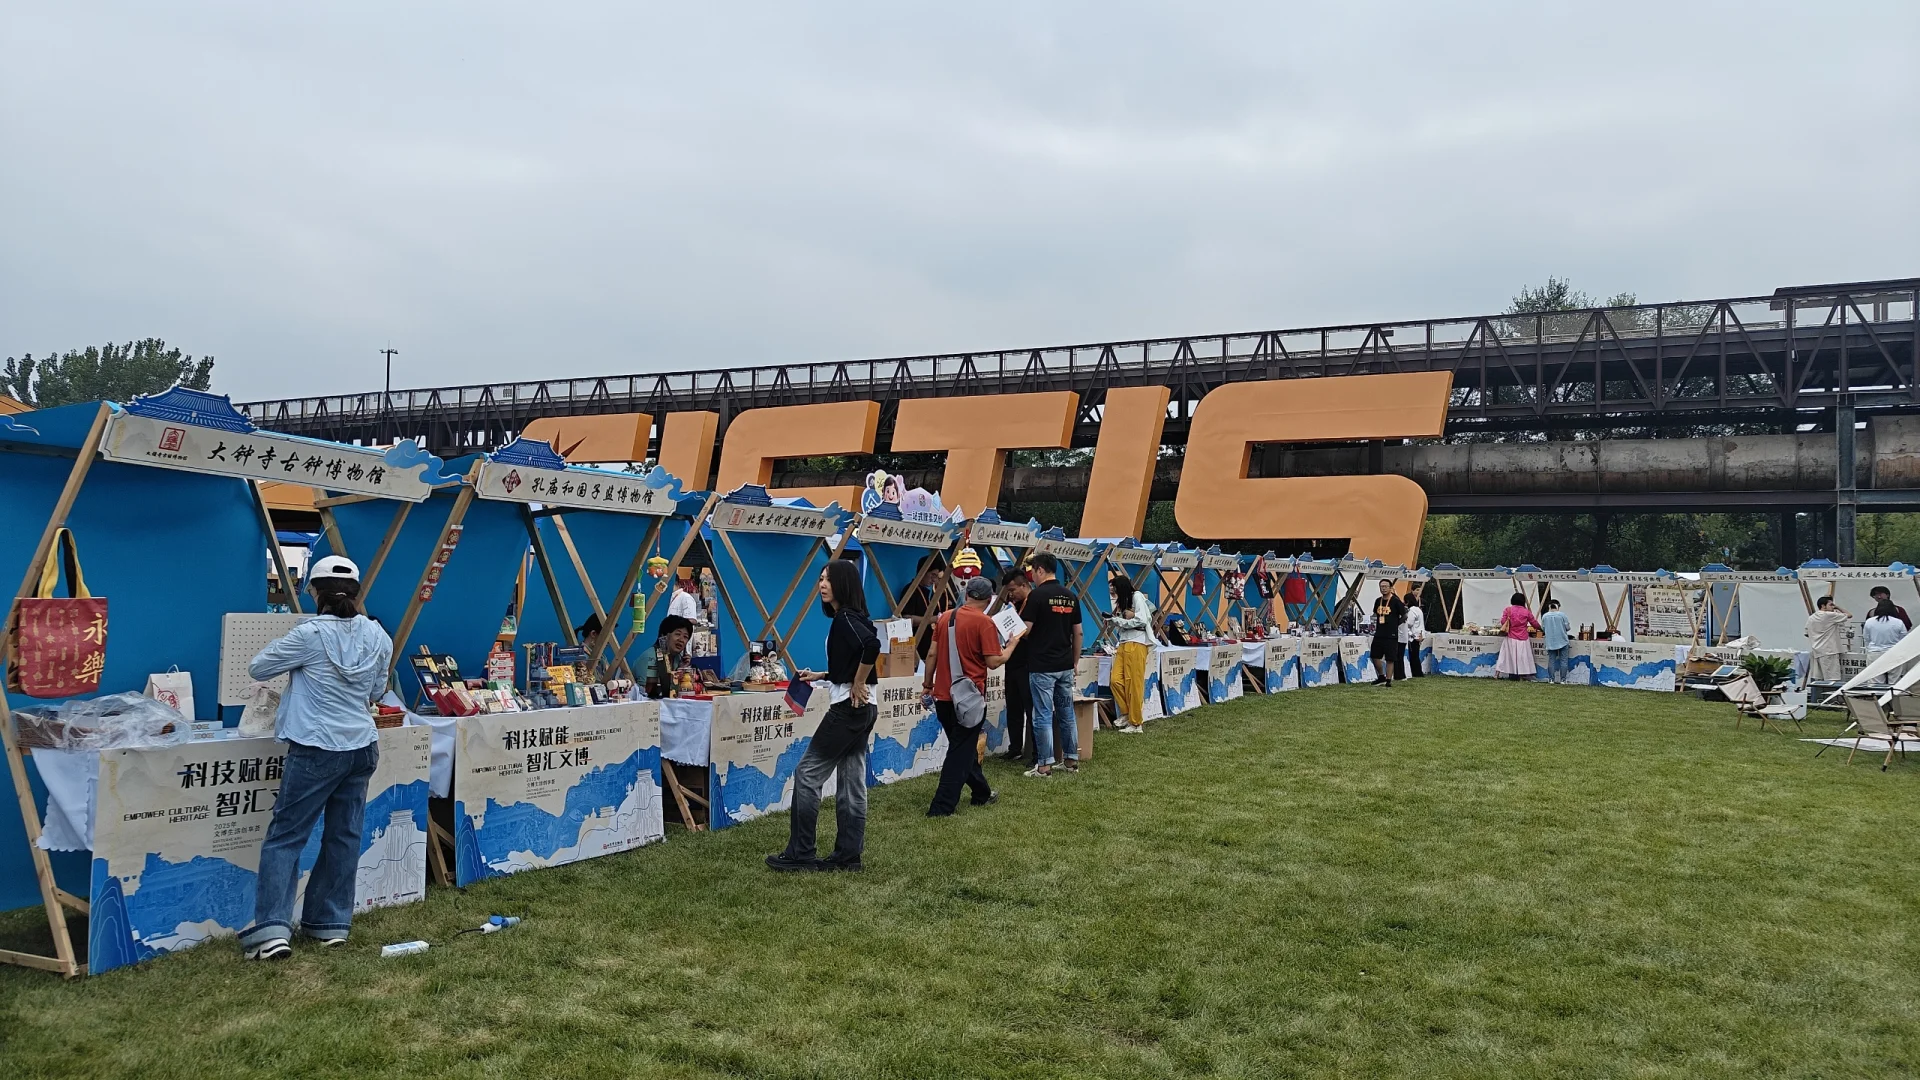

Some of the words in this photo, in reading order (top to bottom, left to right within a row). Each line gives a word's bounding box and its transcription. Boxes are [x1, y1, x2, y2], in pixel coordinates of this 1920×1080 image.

[207, 441, 387, 485] 大钟寺古钟博物馆
[531, 476, 655, 505] 孔庙和国子监博物馆
[746, 512, 826, 530] 北京古代建筑博物馆
[881, 524, 945, 543] 中国人民抗日战争纪念馆
[1448, 638, 1472, 646] 科技赋能
[1607, 646, 1634, 654] 科技赋能
[1615, 653, 1642, 661] 智汇文博
[883, 687, 913, 702] 科技赋能
[741, 704, 783, 724] 科技赋能
[892, 702, 923, 718] 智汇文博
[502, 725, 570, 751] 科技赋能
[754, 722, 795, 742] 智汇文博
[471, 765, 497, 774] EMPOWER
[498, 762, 523, 771] CULTURAL
[526, 746, 592, 773] 智汇文博
[177, 755, 287, 789] 科技赋能
[498, 768, 523, 776] HERITAGE
[123, 809, 165, 821] EMPOWER
[168, 804, 211, 816] CULTURAL
[169, 812, 210, 823] HERITAGE
